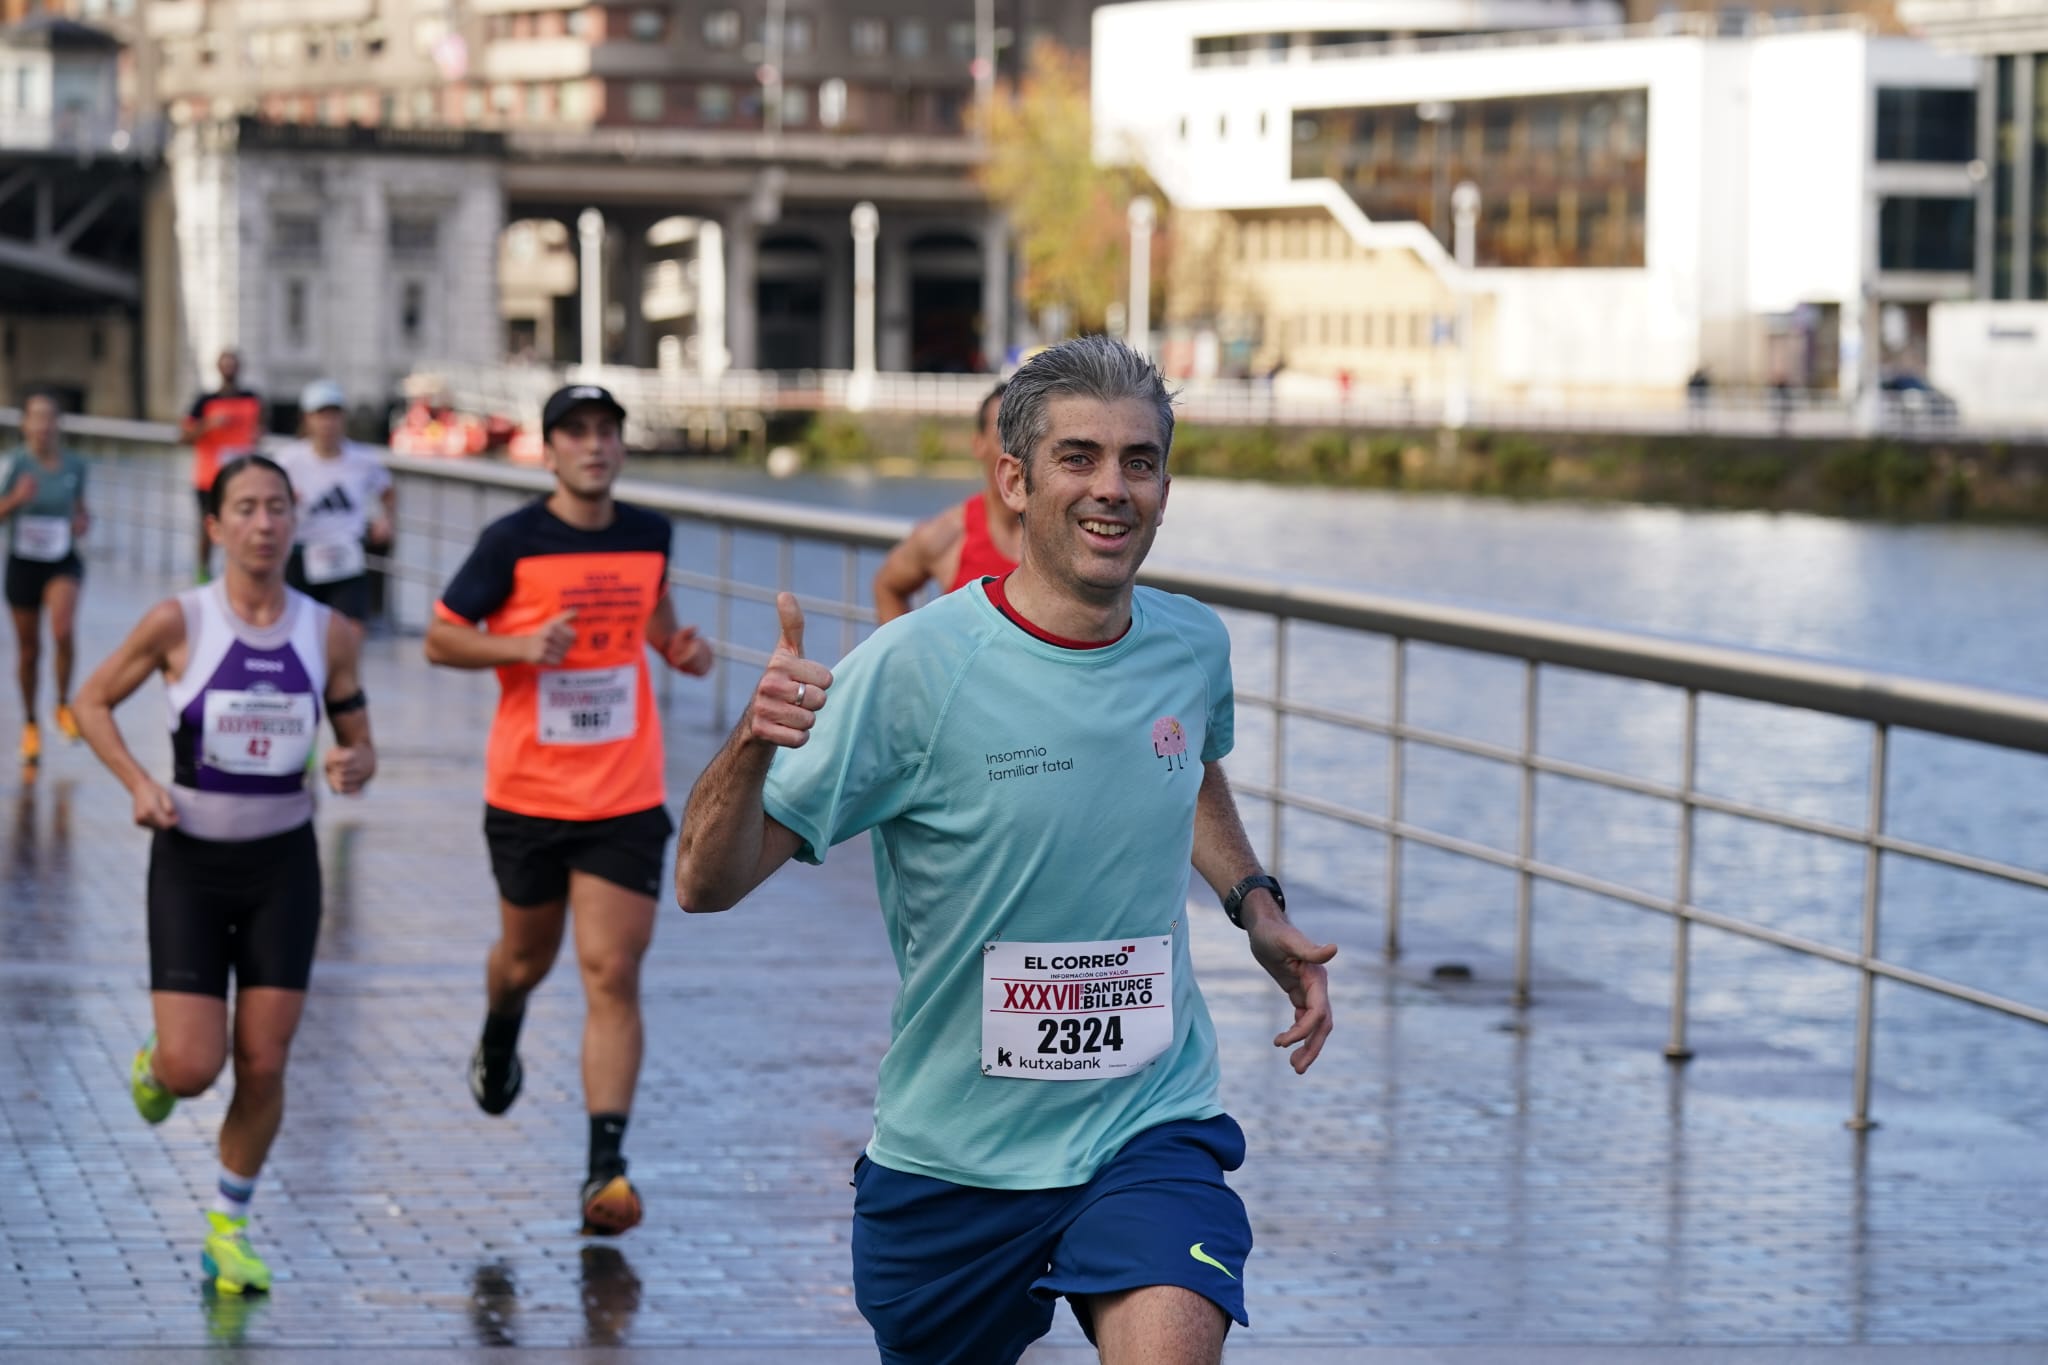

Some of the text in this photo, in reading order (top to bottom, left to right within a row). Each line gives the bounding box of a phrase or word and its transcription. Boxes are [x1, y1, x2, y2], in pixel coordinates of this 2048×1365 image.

[986, 745, 1047, 764] Insomnio
[988, 758, 1074, 780] familiar fatal
[1024, 953, 1128, 970] EL CORREO
[1050, 972, 1094, 980] INFORMACIÓN
[1109, 969, 1129, 977] VALOR
[1003, 983, 1080, 1010] XXXVII
[1084, 978, 1153, 995] SANTURCE
[1083, 990, 1153, 1010] BILBAO
[1038, 1016, 1123, 1054] 2324
[1019, 1056, 1101, 1071] kutxabank
